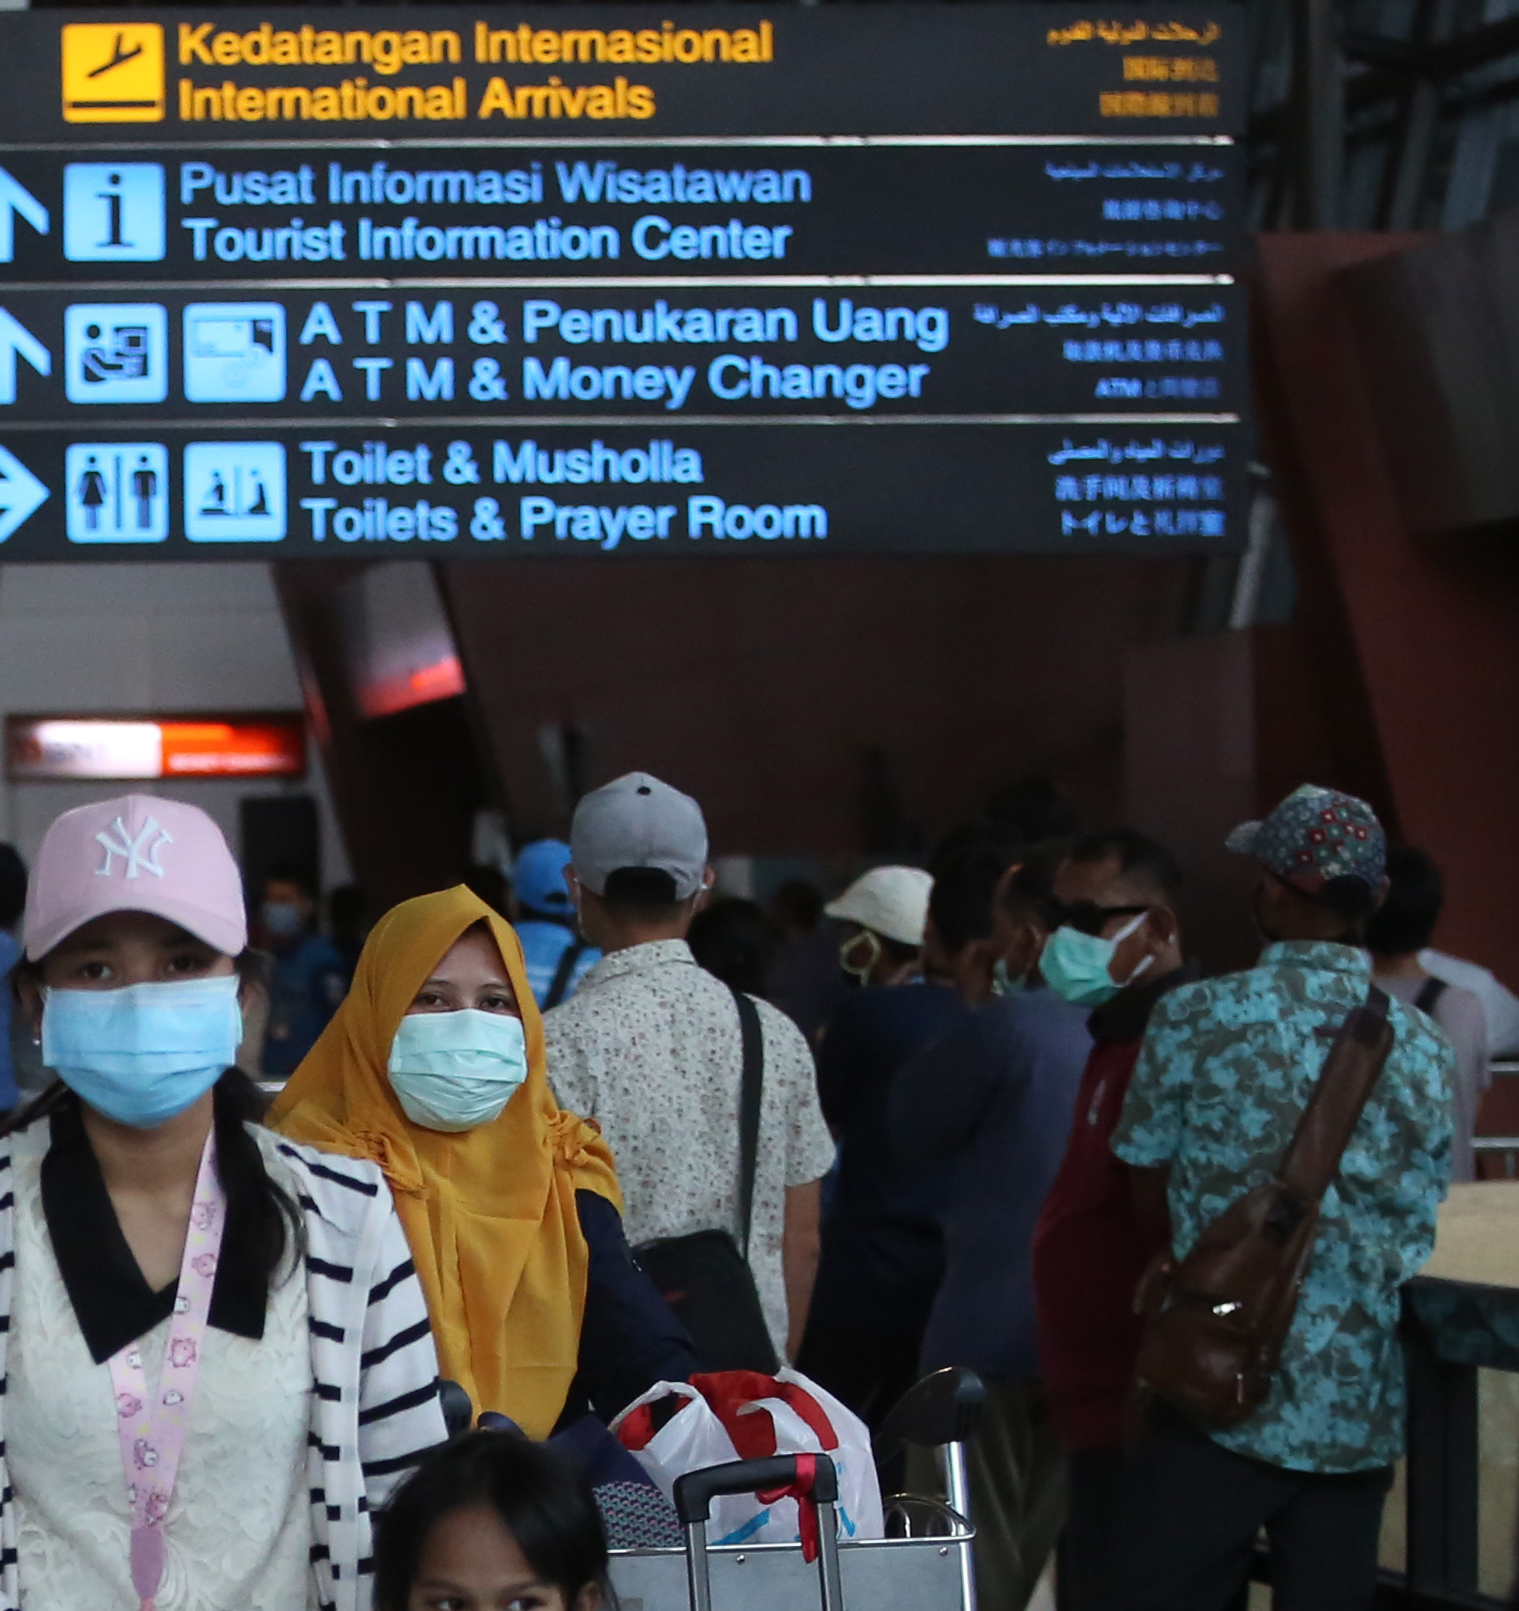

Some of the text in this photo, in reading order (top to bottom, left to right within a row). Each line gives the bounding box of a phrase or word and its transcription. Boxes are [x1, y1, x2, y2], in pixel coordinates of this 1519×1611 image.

[177, 19, 774, 70] Kedatangan Internasional
[177, 77, 656, 121] International Arrivals
[179, 160, 812, 206] Pusat Informasi Wisatawan
[181, 214, 793, 262] Tourist Information Center
[299, 299, 950, 354] A T M & Penukaran Uang
[299, 355, 930, 411] A T M & Money Changer
[300, 440, 704, 486] Toilet & Musholla
[300, 497, 828, 550] Toilets & Prayer Room
[94, 816, 174, 879] NY
